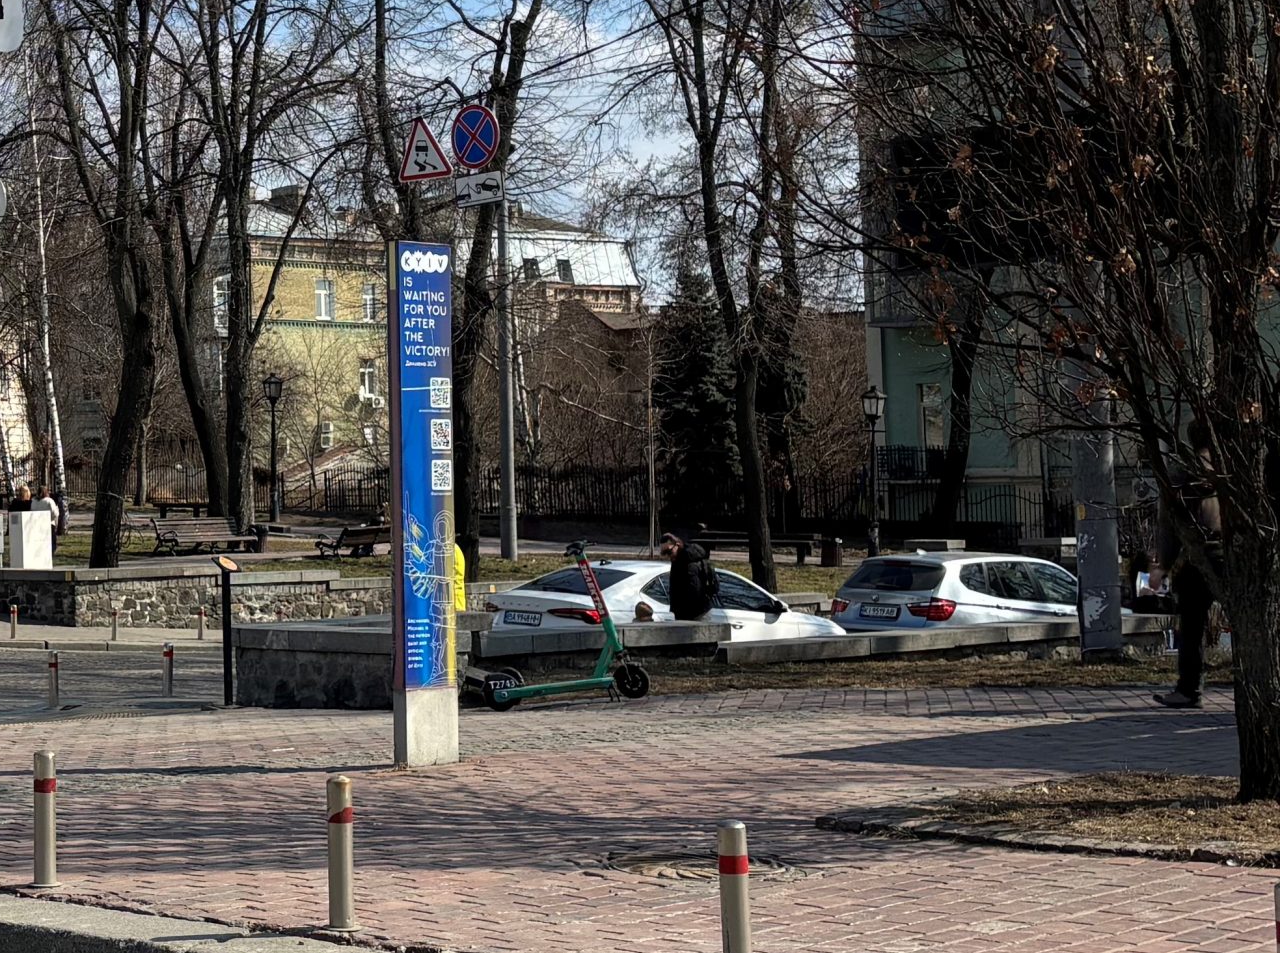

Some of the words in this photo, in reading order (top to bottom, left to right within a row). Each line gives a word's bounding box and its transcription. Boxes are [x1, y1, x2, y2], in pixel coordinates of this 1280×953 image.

[403, 255, 444, 269] KYIV
[403, 276, 413, 287] IS
[403, 290, 445, 302] WAITING
[404, 304, 424, 315] FOR
[426, 305, 447, 316] YOU
[404, 318, 435, 329] AFTER
[404, 331, 424, 342] THE
[404, 345, 450, 357] VICTORY!
[488, 679, 516, 690] T2743
